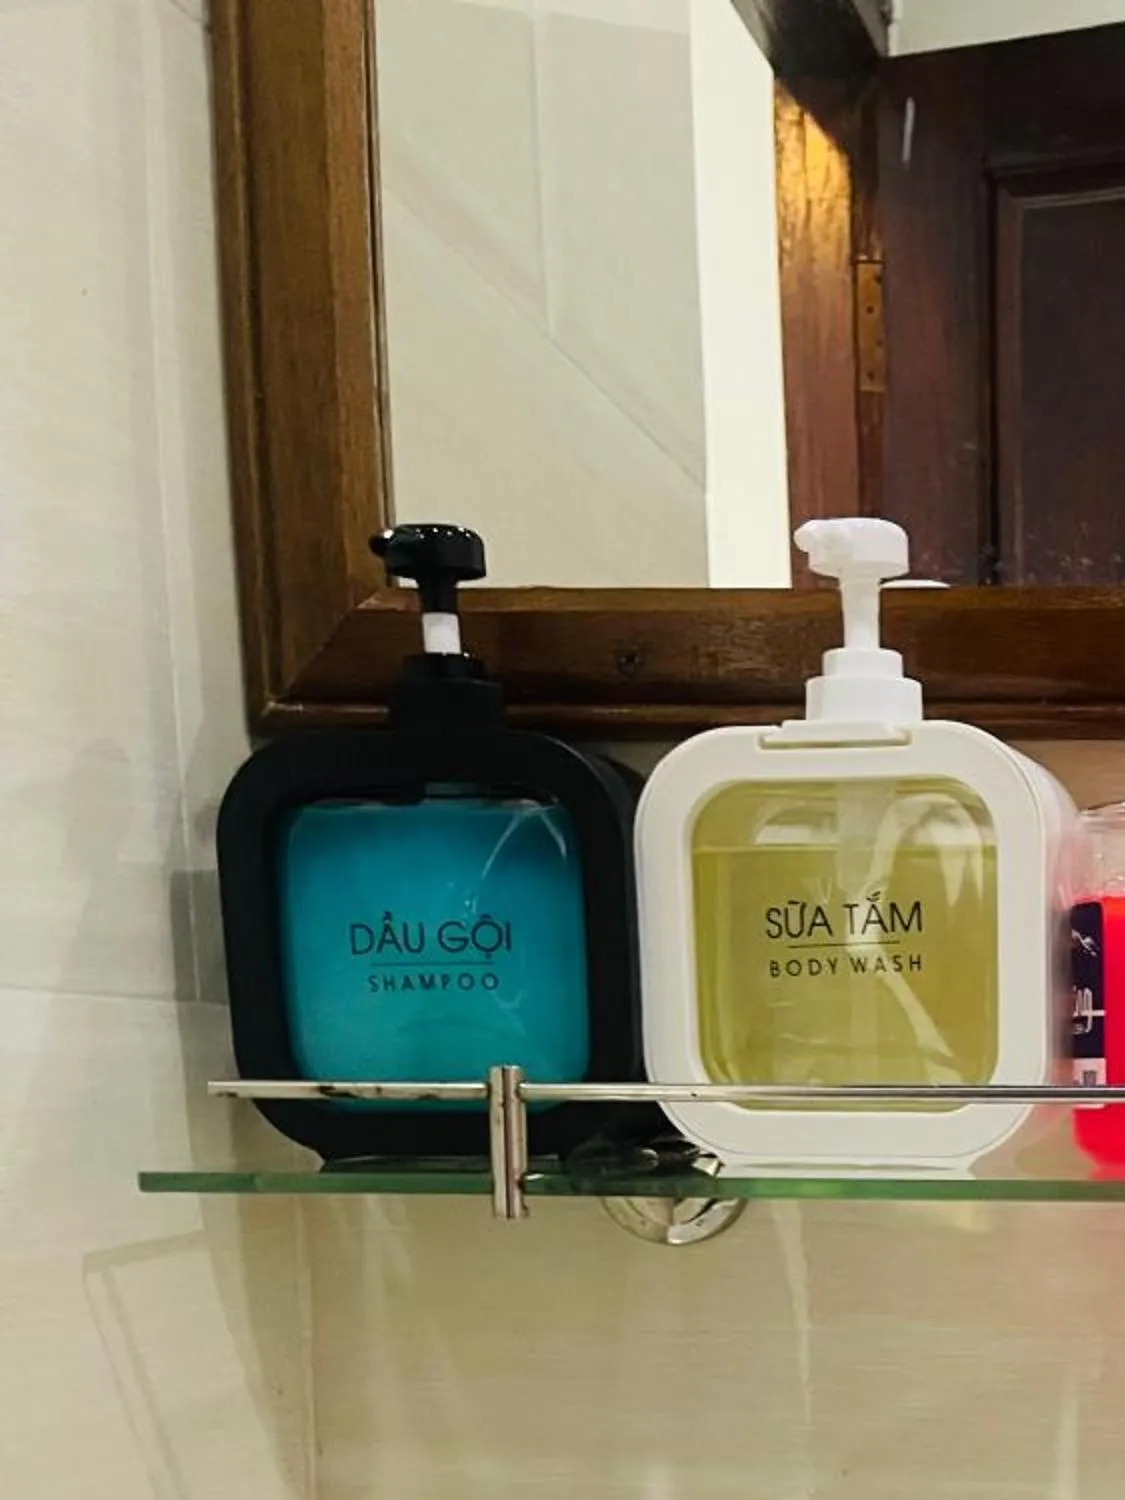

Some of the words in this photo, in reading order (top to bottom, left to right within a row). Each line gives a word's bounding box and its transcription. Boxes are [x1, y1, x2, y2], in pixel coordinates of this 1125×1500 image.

[765, 900, 834, 939] SỮA
[842, 891, 923, 935] TẮM
[349, 910, 425, 956] DẦU
[437, 913, 512, 959] GỘI
[367, 972, 500, 993] SHAMPOO
[769, 957, 839, 978] BODY
[850, 953, 923, 974] WASH
